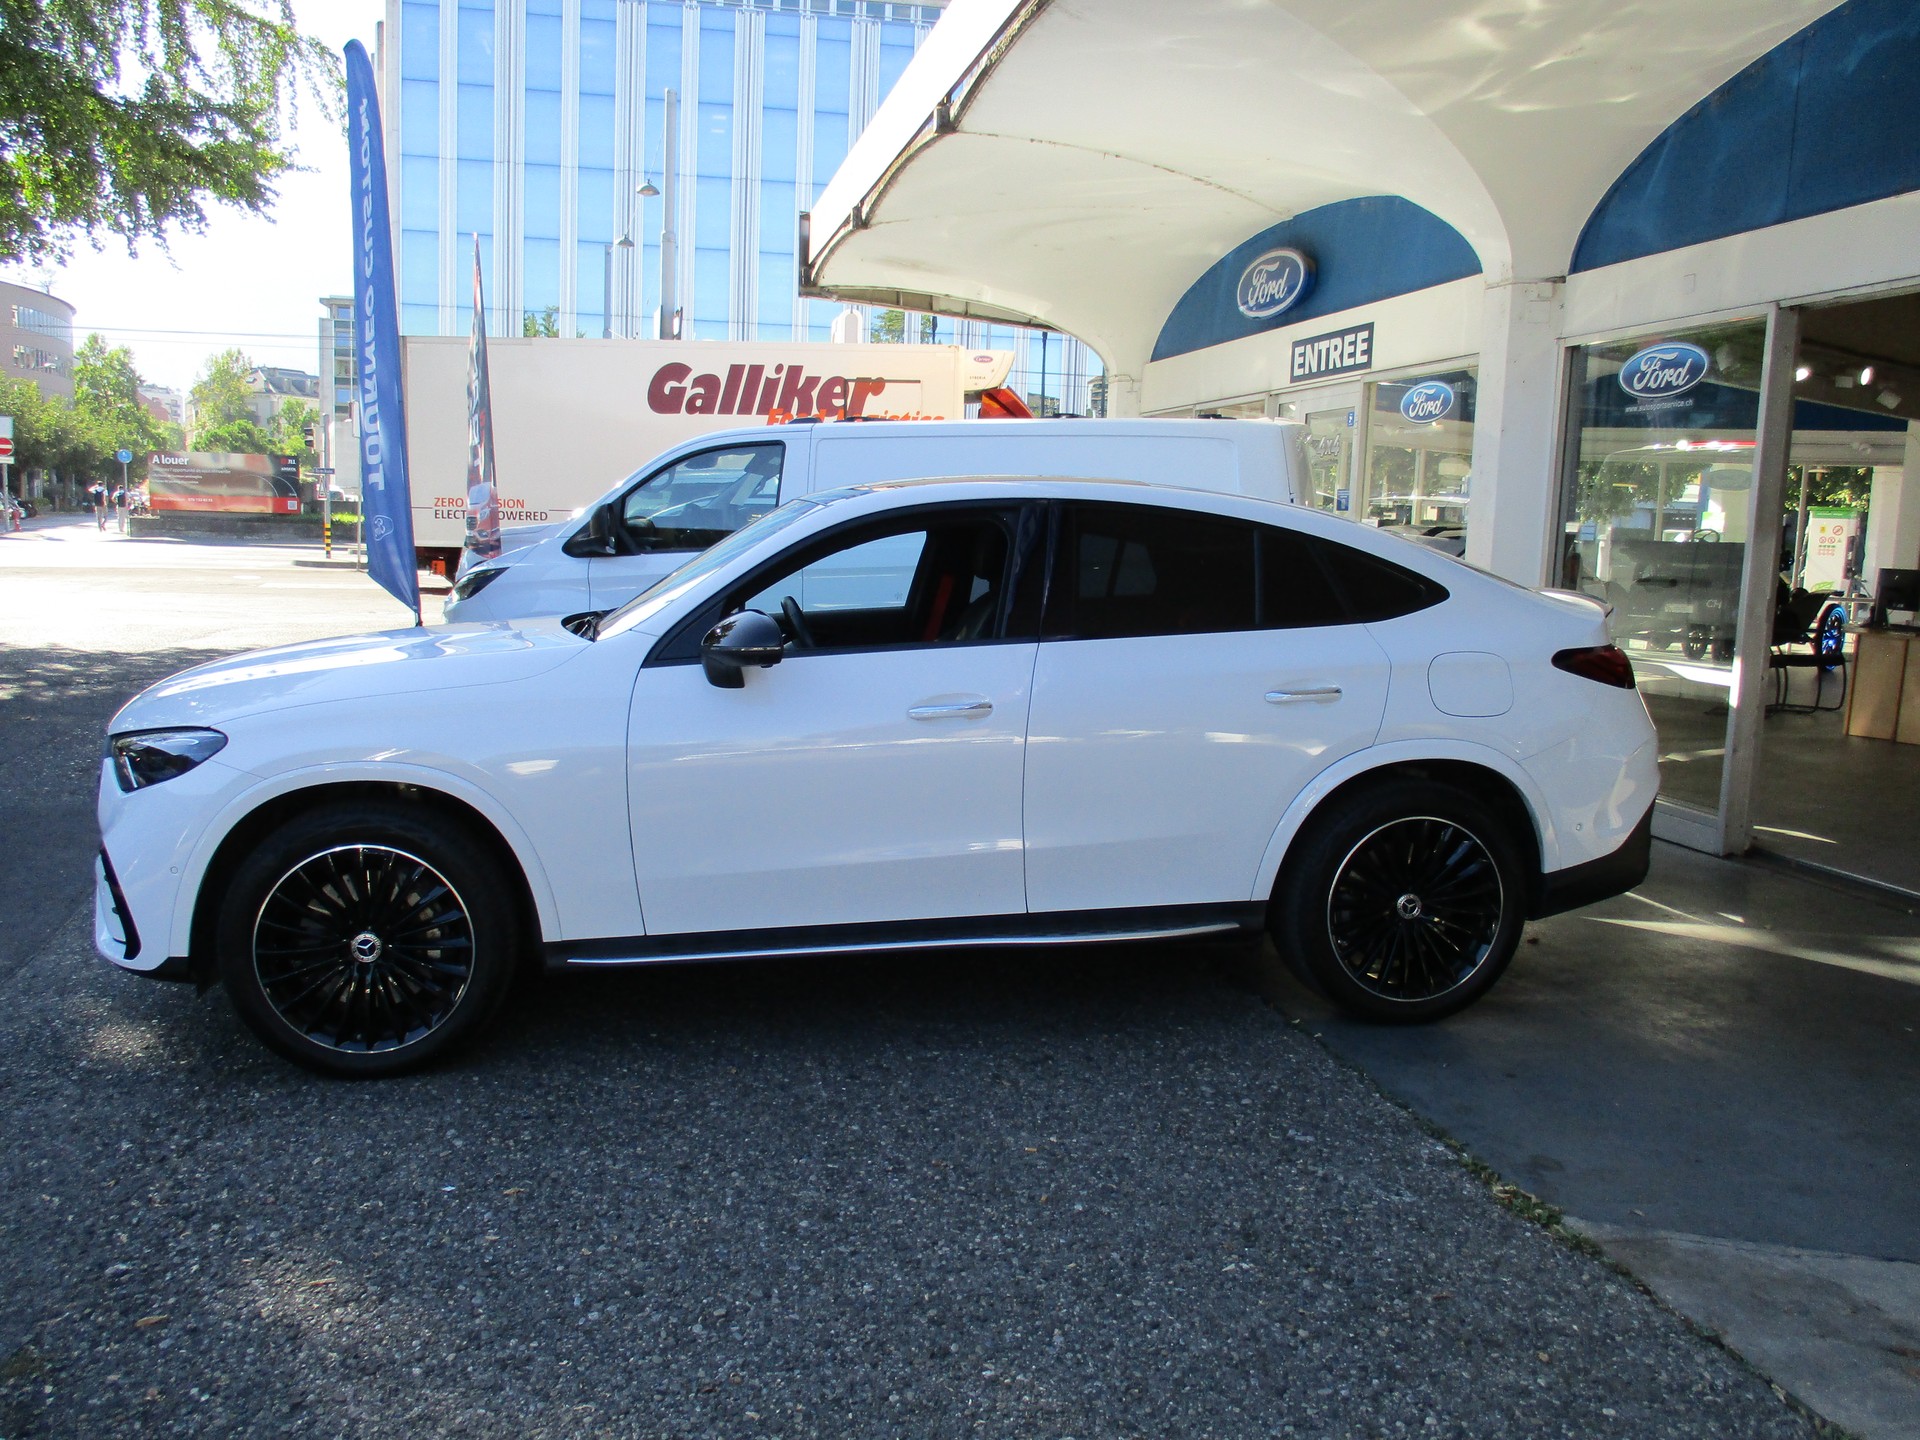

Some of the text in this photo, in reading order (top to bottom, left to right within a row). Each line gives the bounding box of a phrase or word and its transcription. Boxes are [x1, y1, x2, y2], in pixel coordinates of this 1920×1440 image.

[1247, 261, 1290, 307] Ford
[1293, 331, 1369, 376] ENTREE
[1633, 352, 1691, 390] Ford
[647, 361, 886, 417] Galliker
[1408, 387, 1445, 418] Ford
[161, 454, 190, 465] louer
[434, 497, 464, 508] ZERO
[498, 510, 548, 521] OWERED
